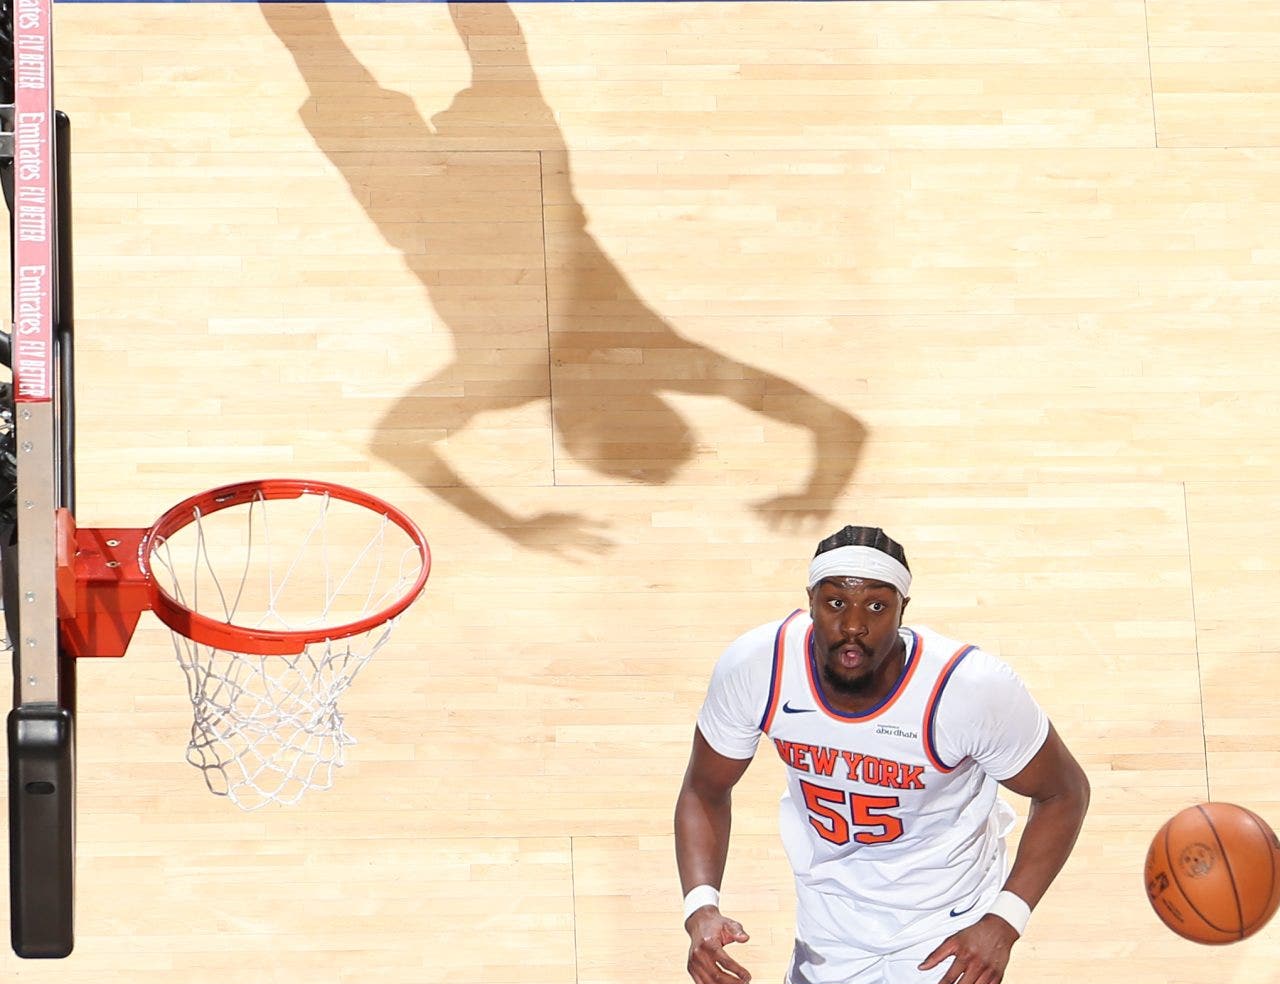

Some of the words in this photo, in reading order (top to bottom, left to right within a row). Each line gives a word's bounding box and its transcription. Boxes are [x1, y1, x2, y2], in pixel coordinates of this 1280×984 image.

[18, 0, 43, 30] ates
[18, 34, 45, 53] FLY
[18, 53, 45, 89] BETTER
[18, 111, 46, 180] Emirates
[19, 186, 46, 204] FLY
[19, 205, 46, 241] BETTER
[19, 264, 46, 335] Emirates
[19, 340, 46, 357] FLY
[18, 359, 46, 397] BETTER
[773, 738, 839, 777] NEW
[841, 751, 926, 790] YORK
[799, 778, 905, 846] 55
